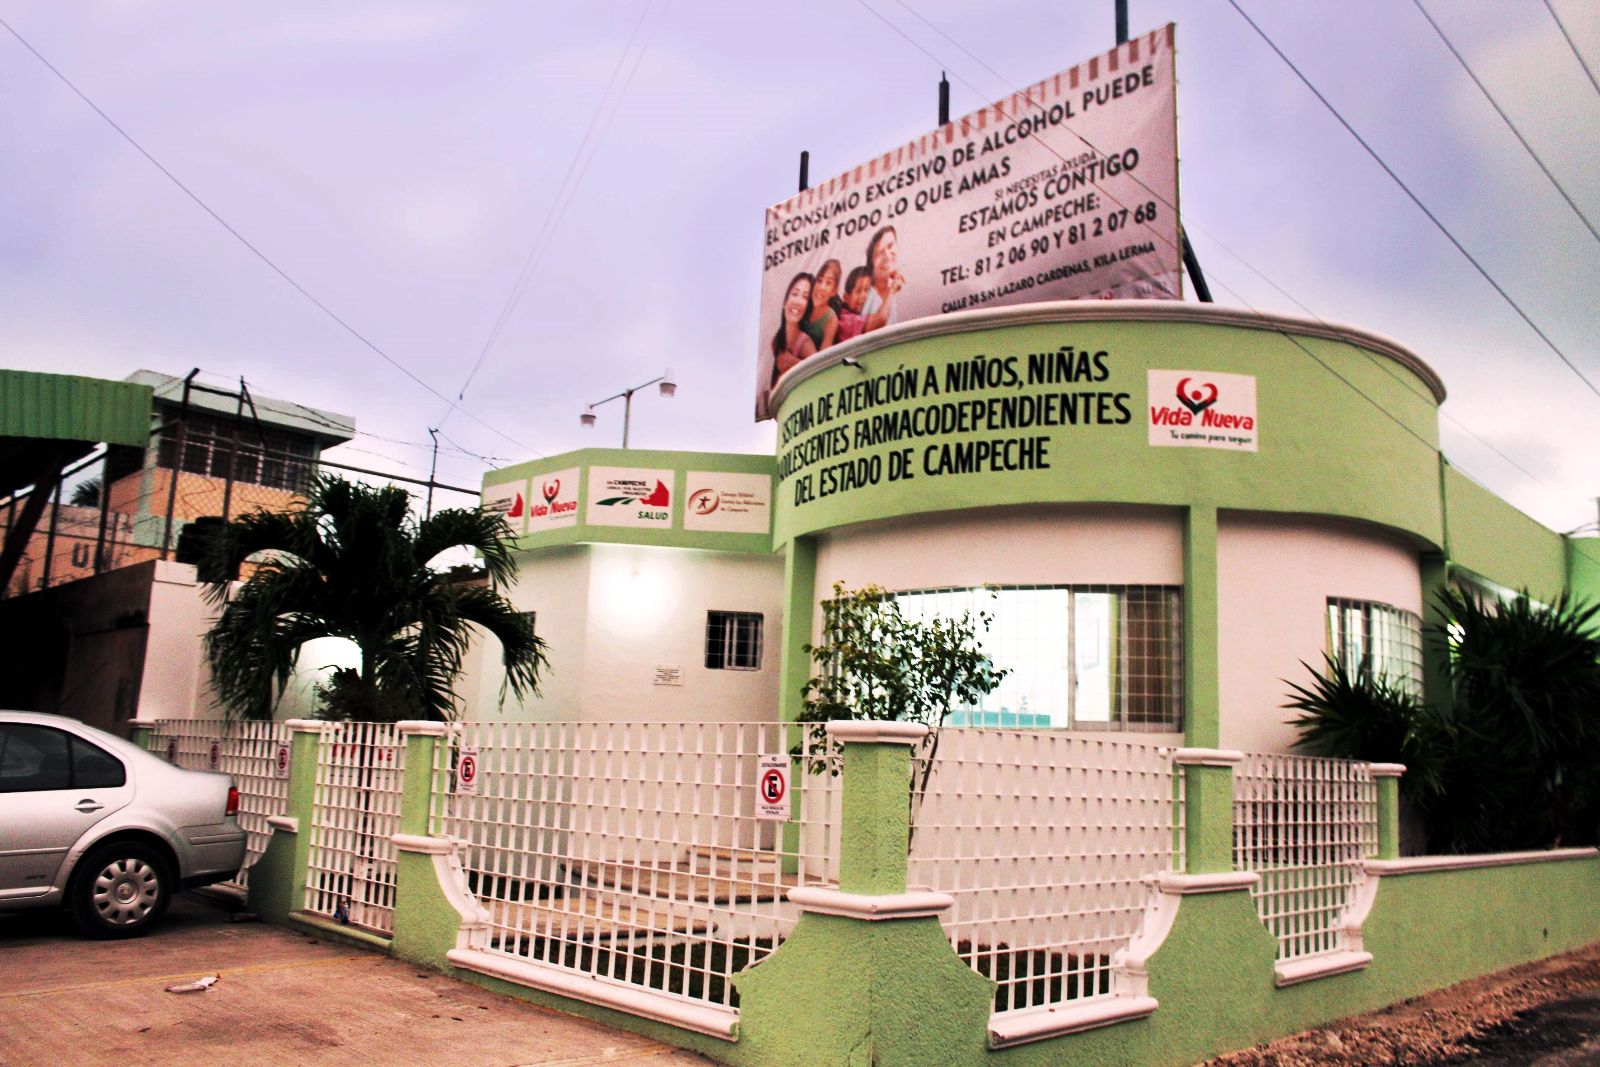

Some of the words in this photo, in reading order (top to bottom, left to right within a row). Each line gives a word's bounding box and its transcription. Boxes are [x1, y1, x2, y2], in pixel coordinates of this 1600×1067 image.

[766, 227, 779, 247] EL
[782, 192, 860, 236] CONSUMO
[866, 155, 946, 203] EXCESIVO
[953, 142, 975, 167] DE
[980, 101, 1076, 155] ALCOHOL
[1083, 64, 1154, 111] PUEDE
[959, 186, 1038, 233] ESTAMOS
[1044, 148, 1139, 200] CONTIGO
[765, 228, 830, 272] DESTRUIR
[836, 208, 882, 240] TODO
[888, 197, 908, 218] LO
[915, 180, 953, 211] QUE
[958, 156, 1011, 195] AMAS
[941, 266, 971, 287] TEL:
[975, 258, 991, 277] 81
[996, 251, 1005, 269] 2
[1008, 244, 1026, 265] 06
[1031, 235, 1049, 257] 90
[1053, 229, 1064, 250] Y
[1068, 222, 1086, 245] 81
[1092, 217, 1103, 238] 2
[1107, 208, 1129, 232] 07
[1134, 201, 1157, 225] 68
[988, 227, 1006, 248] EN
[1011, 192, 1101, 239] CAMPECHE:
[941, 296, 967, 314] CALLE
[998, 276, 1035, 298] LAZARO
[1119, 241, 1156, 260] LERMA
[817, 392, 834, 425] DE
[837, 363, 918, 418] ATENCIÓN
[922, 365, 940, 397] A
[945, 354, 1024, 391] NIÑOS,
[1028, 346, 1109, 385] NIÑAS
[854, 392, 1132, 450] FARMACODEPENDIENTES
[1150, 405, 1192, 426] Vida
[1200, 407, 1254, 431] Nueva
[794, 473, 815, 507] DEL
[819, 454, 882, 498] ESTADO
[888, 448, 914, 482] DE
[923, 436, 1051, 476] CAMPECHE
[638, 511, 669, 520] SALUD
